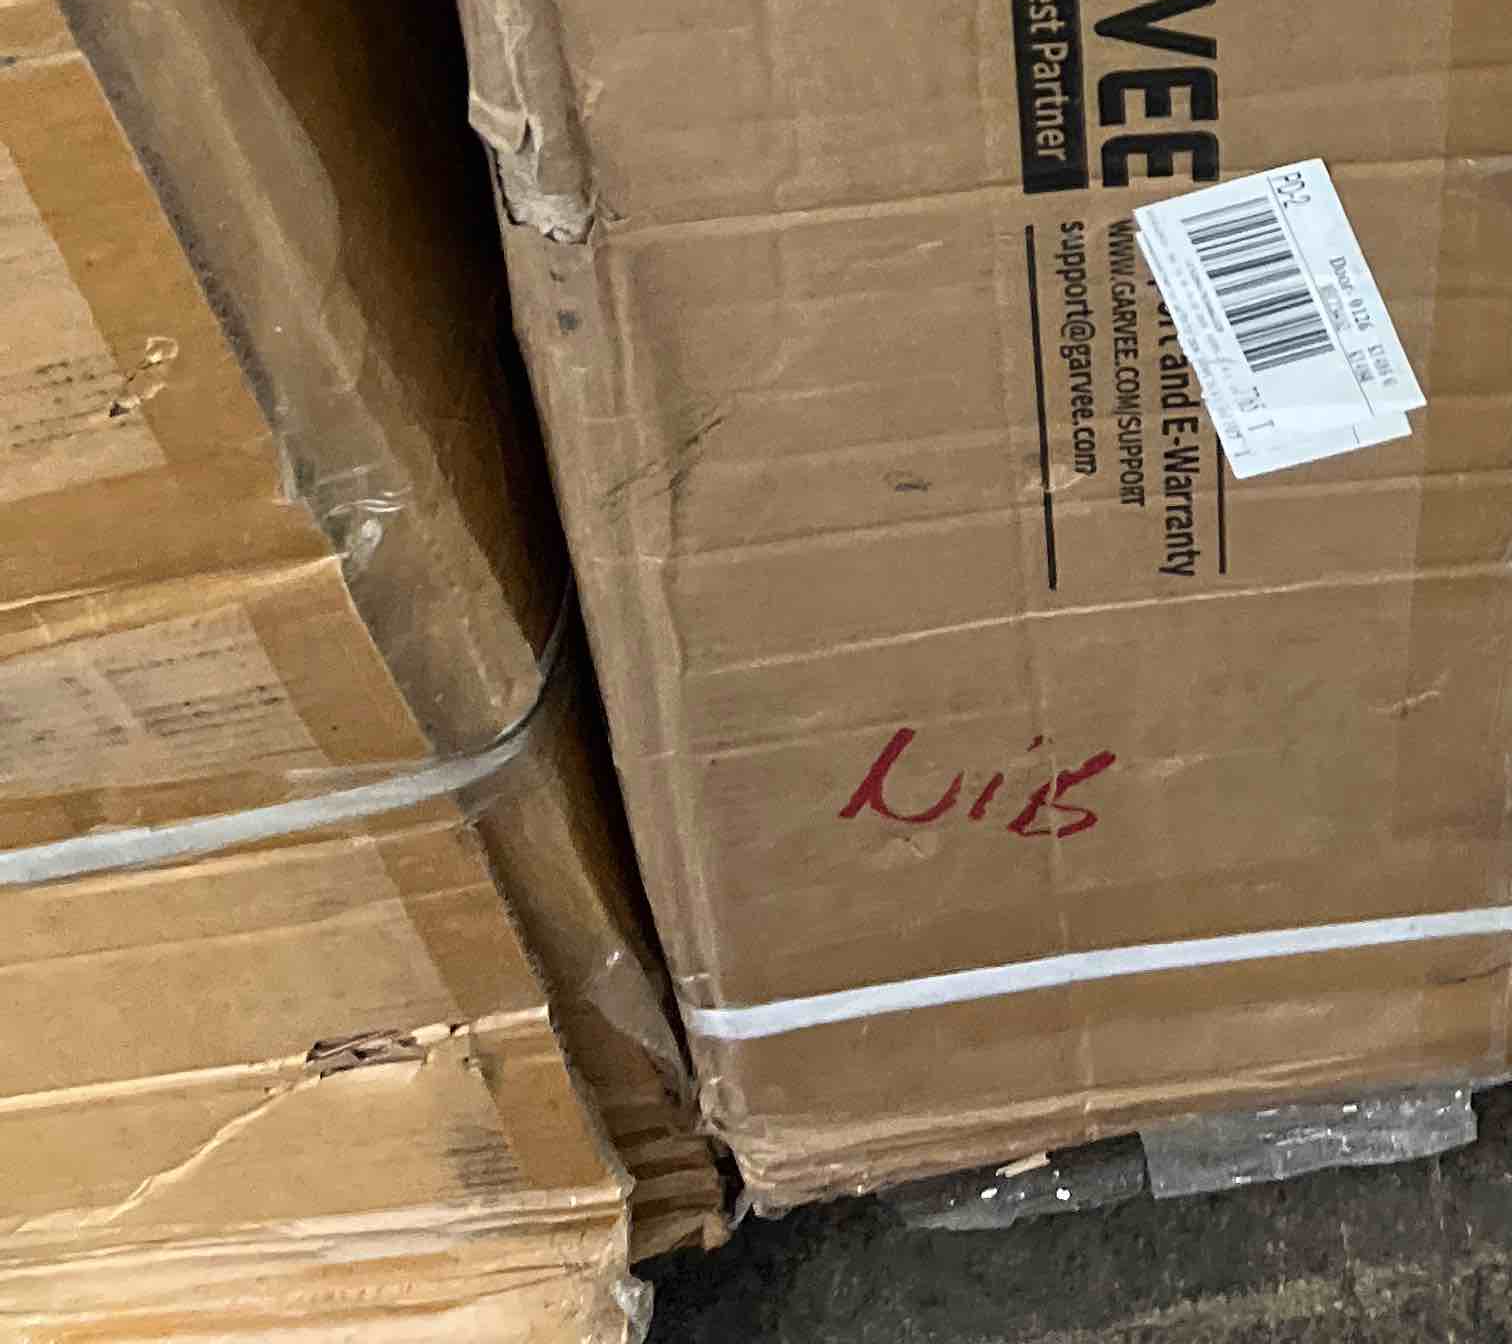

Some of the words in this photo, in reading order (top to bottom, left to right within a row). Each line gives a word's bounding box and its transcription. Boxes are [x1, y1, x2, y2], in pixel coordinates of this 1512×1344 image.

[1031, 40, 1071, 163] Partner
[1056, 220, 1097, 477] support@garvee.com
[1159, 354, 1201, 412] and
[1159, 413, 1202, 577] E-Warranty
